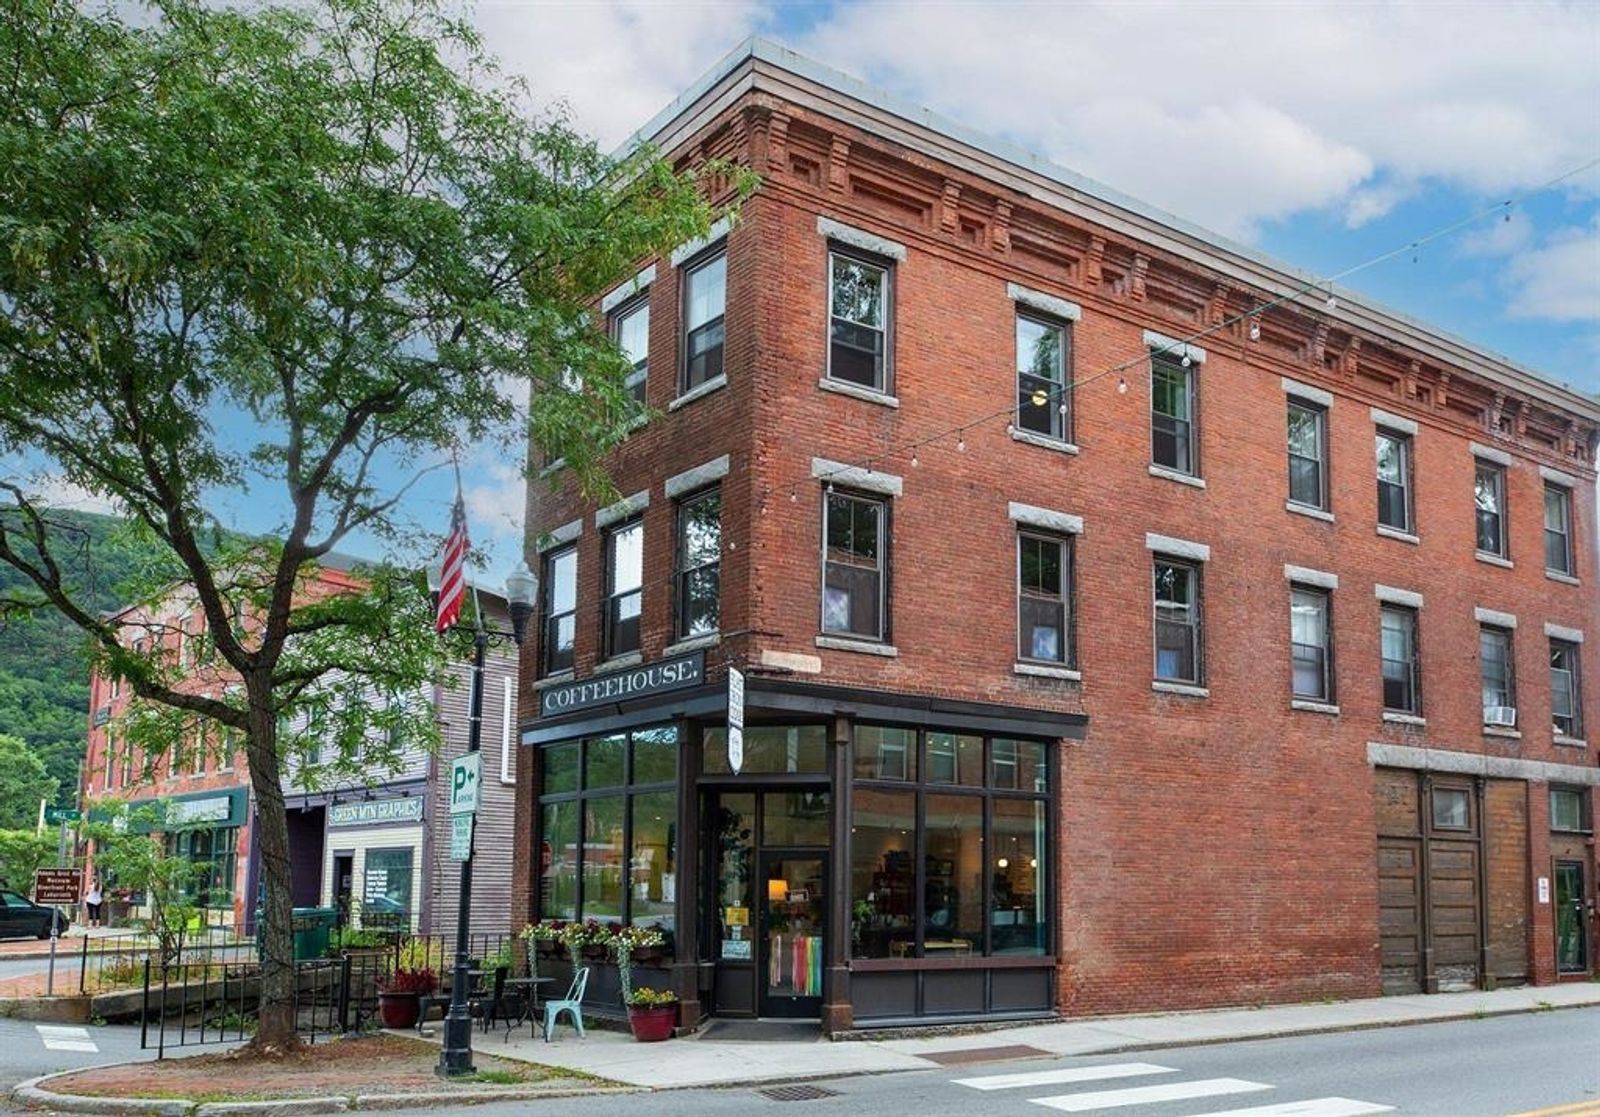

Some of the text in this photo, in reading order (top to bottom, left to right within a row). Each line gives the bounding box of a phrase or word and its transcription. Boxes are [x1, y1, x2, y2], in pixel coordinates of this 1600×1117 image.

[545, 660, 698, 710] COFFEEHOUSE.
[334, 801, 418, 822] GREEN MTN GRAPHICS
